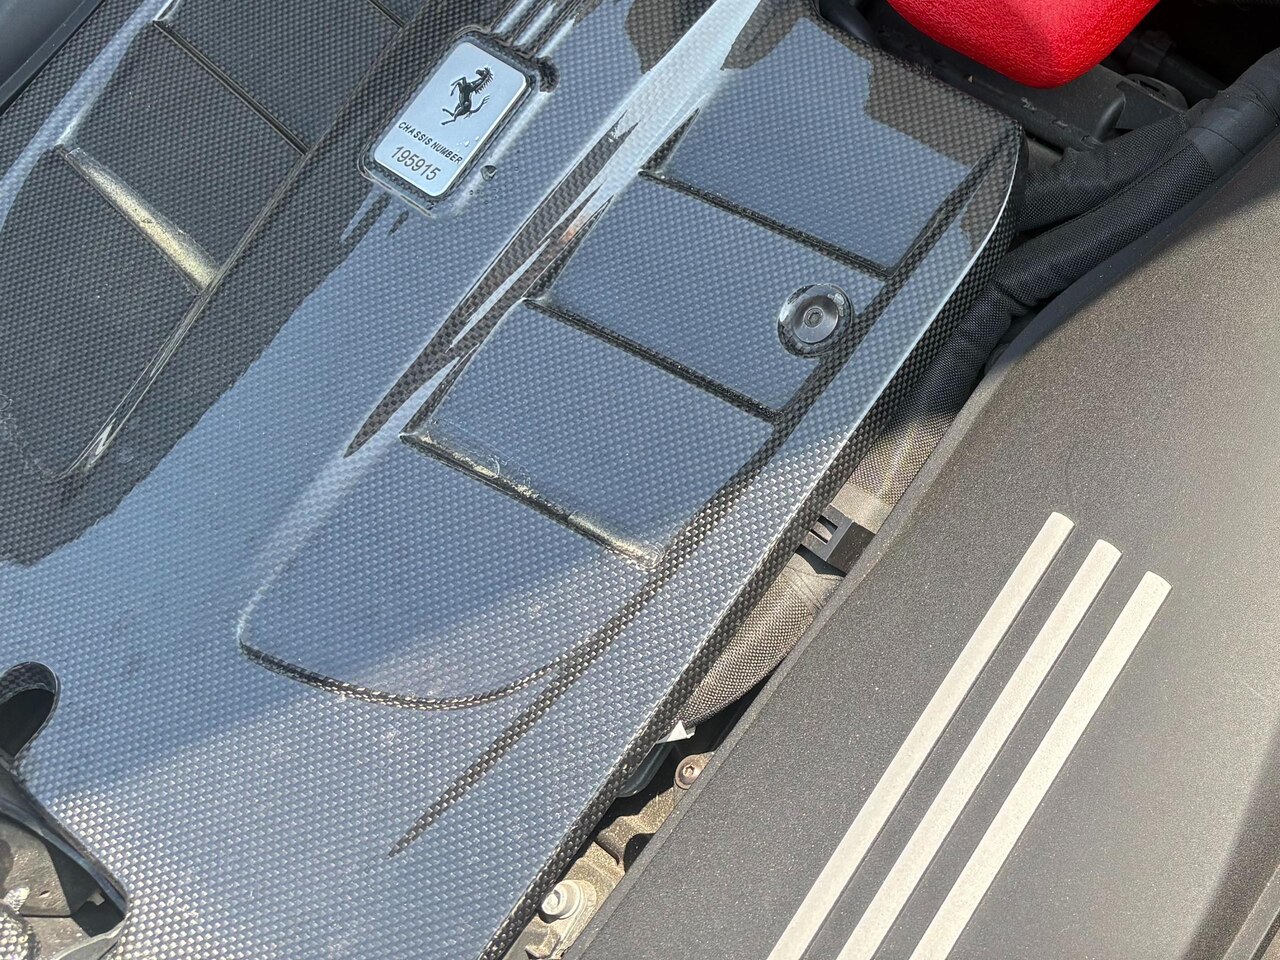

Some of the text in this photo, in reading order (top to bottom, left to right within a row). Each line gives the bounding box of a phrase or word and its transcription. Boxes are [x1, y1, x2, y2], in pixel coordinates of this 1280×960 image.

[398, 121, 463, 165] CHASSIS NUMBER
[391, 145, 442, 182] 195915
